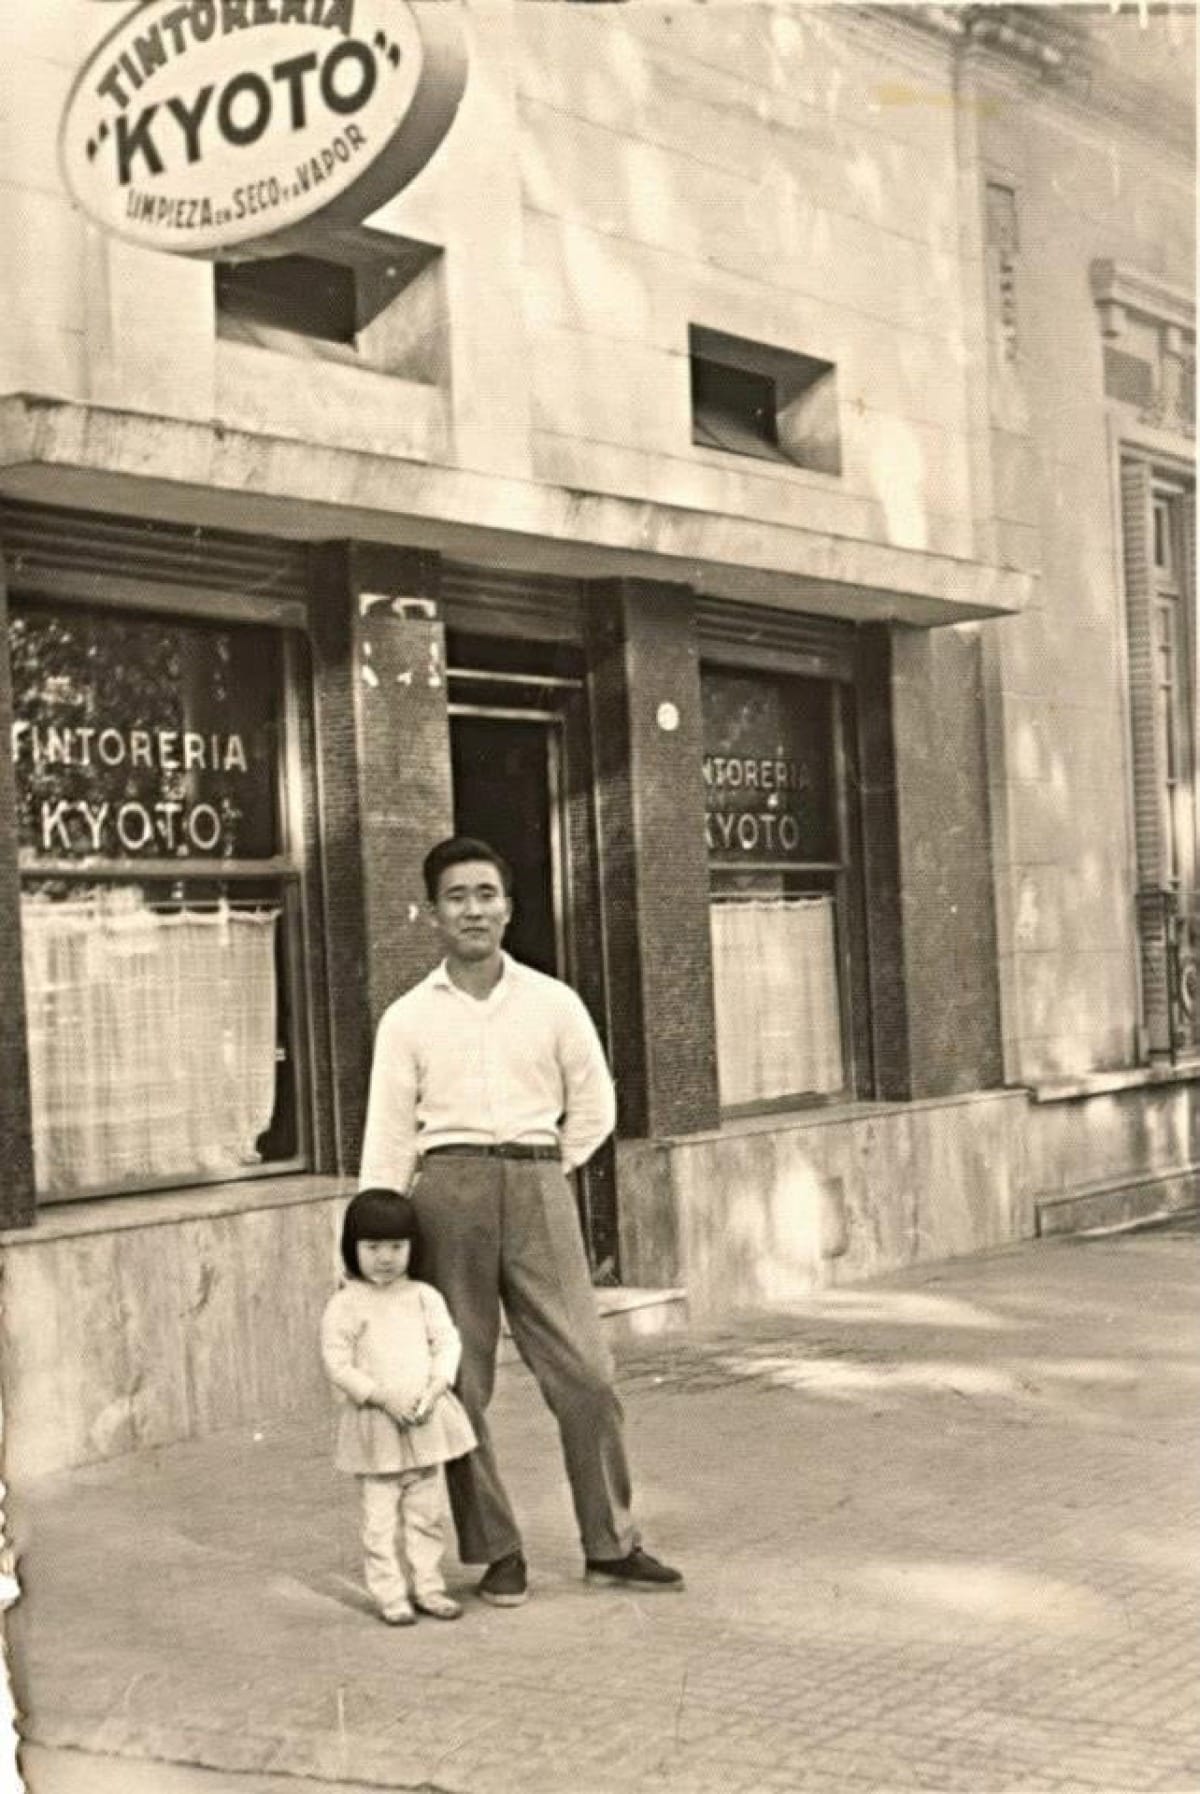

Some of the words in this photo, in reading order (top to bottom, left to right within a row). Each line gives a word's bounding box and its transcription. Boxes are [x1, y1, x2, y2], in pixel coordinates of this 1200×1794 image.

[126, 188, 213, 229] LIMPIEZA
[232, 176, 280, 219] SECO
[296, 123, 367, 192] VAPOR
[11, 720, 248, 772] TINTORERIA
[41, 800, 221, 850] KYOTO
